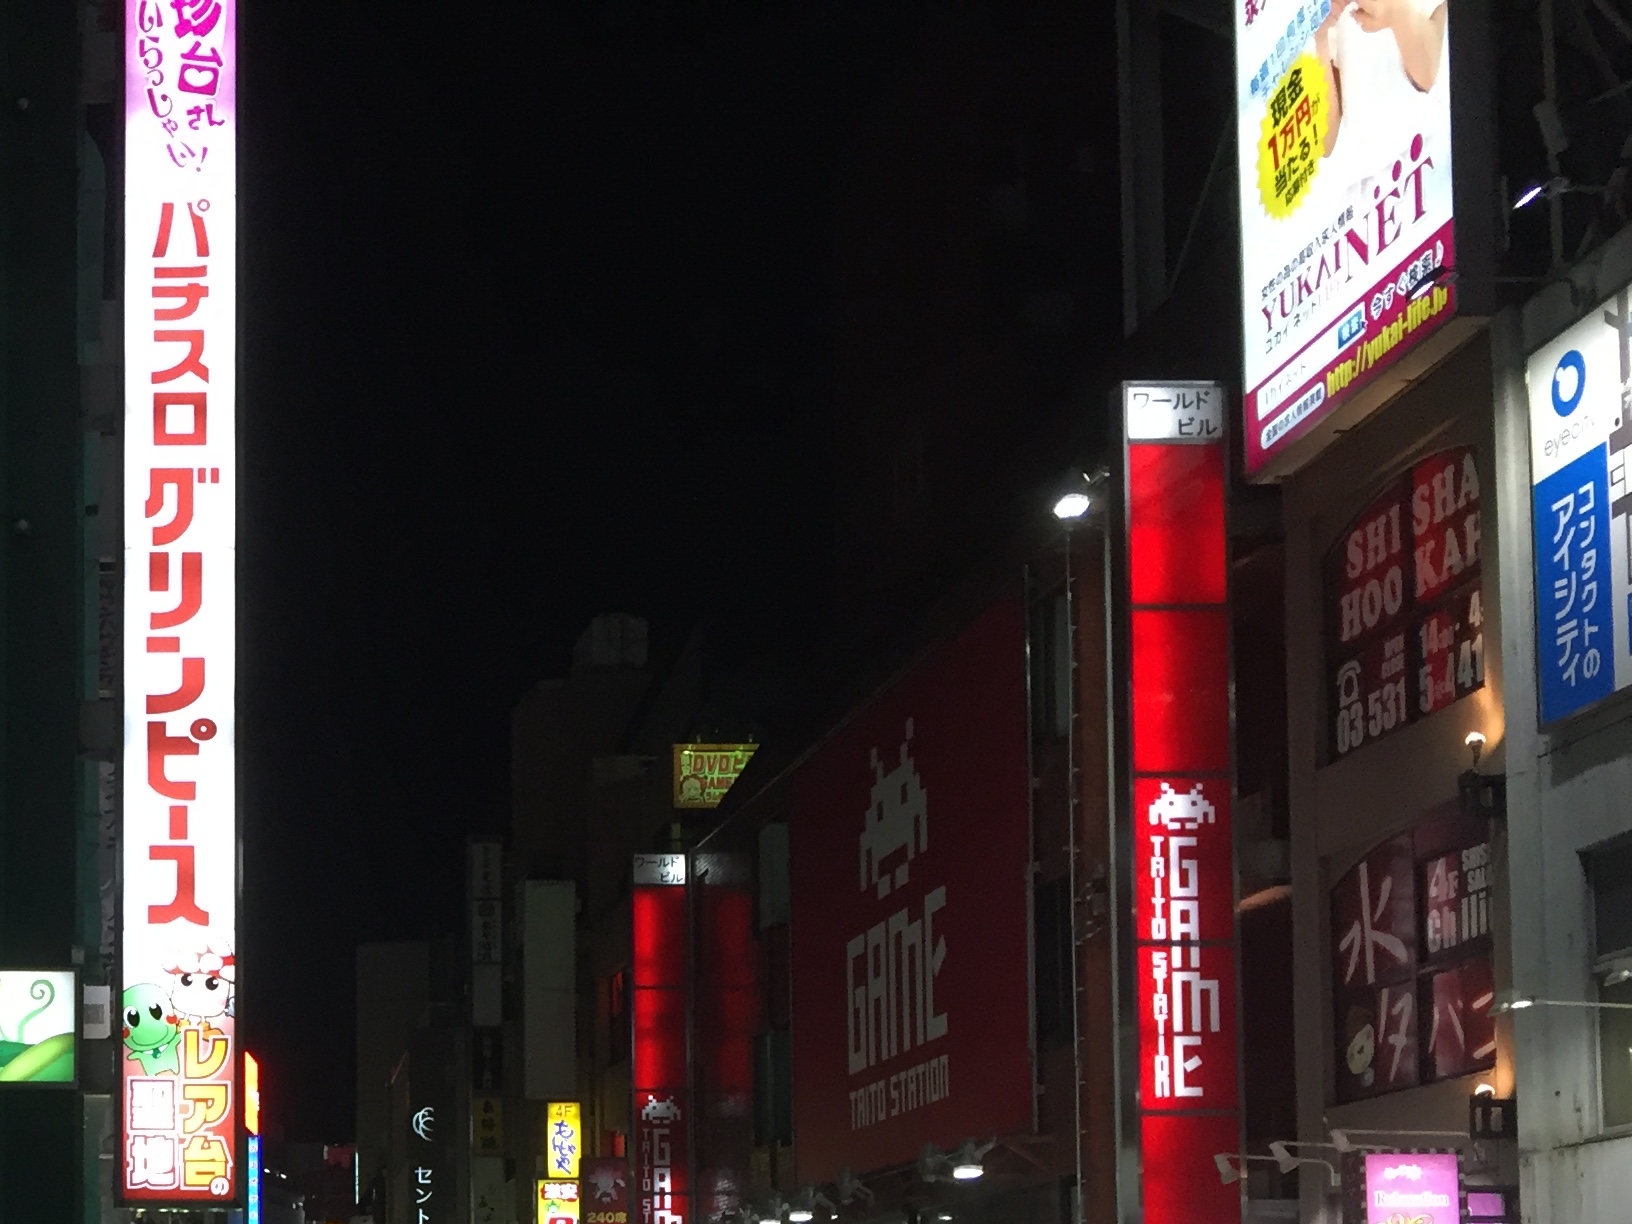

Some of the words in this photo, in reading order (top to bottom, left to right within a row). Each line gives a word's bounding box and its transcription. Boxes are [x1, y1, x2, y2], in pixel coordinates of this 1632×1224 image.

[1271, 67, 1304, 129] 現金
[1133, 390, 1211, 411] ワールド
[1178, 417, 1219, 437] ビル
[145, 199, 219, 927] パチスログリンピース
[1549, 491, 1578, 687] アイシティ
[1578, 480, 1601, 680] コンタクトの
[634, 855, 681, 870] ワールド
[659, 870, 684, 886] ビル
[1150, 835, 1167, 940] TAITO
[1338, 861, 1409, 985] 水
[846, 884, 949, 1076] GAME
[1151, 951, 1171, 1098] STATION
[1169, 836, 1221, 1098] GAME
[179, 1027, 235, 1197] レア台の
[849, 1080, 887, 1131] TAITO
[889, 1054, 950, 1117] STATION
